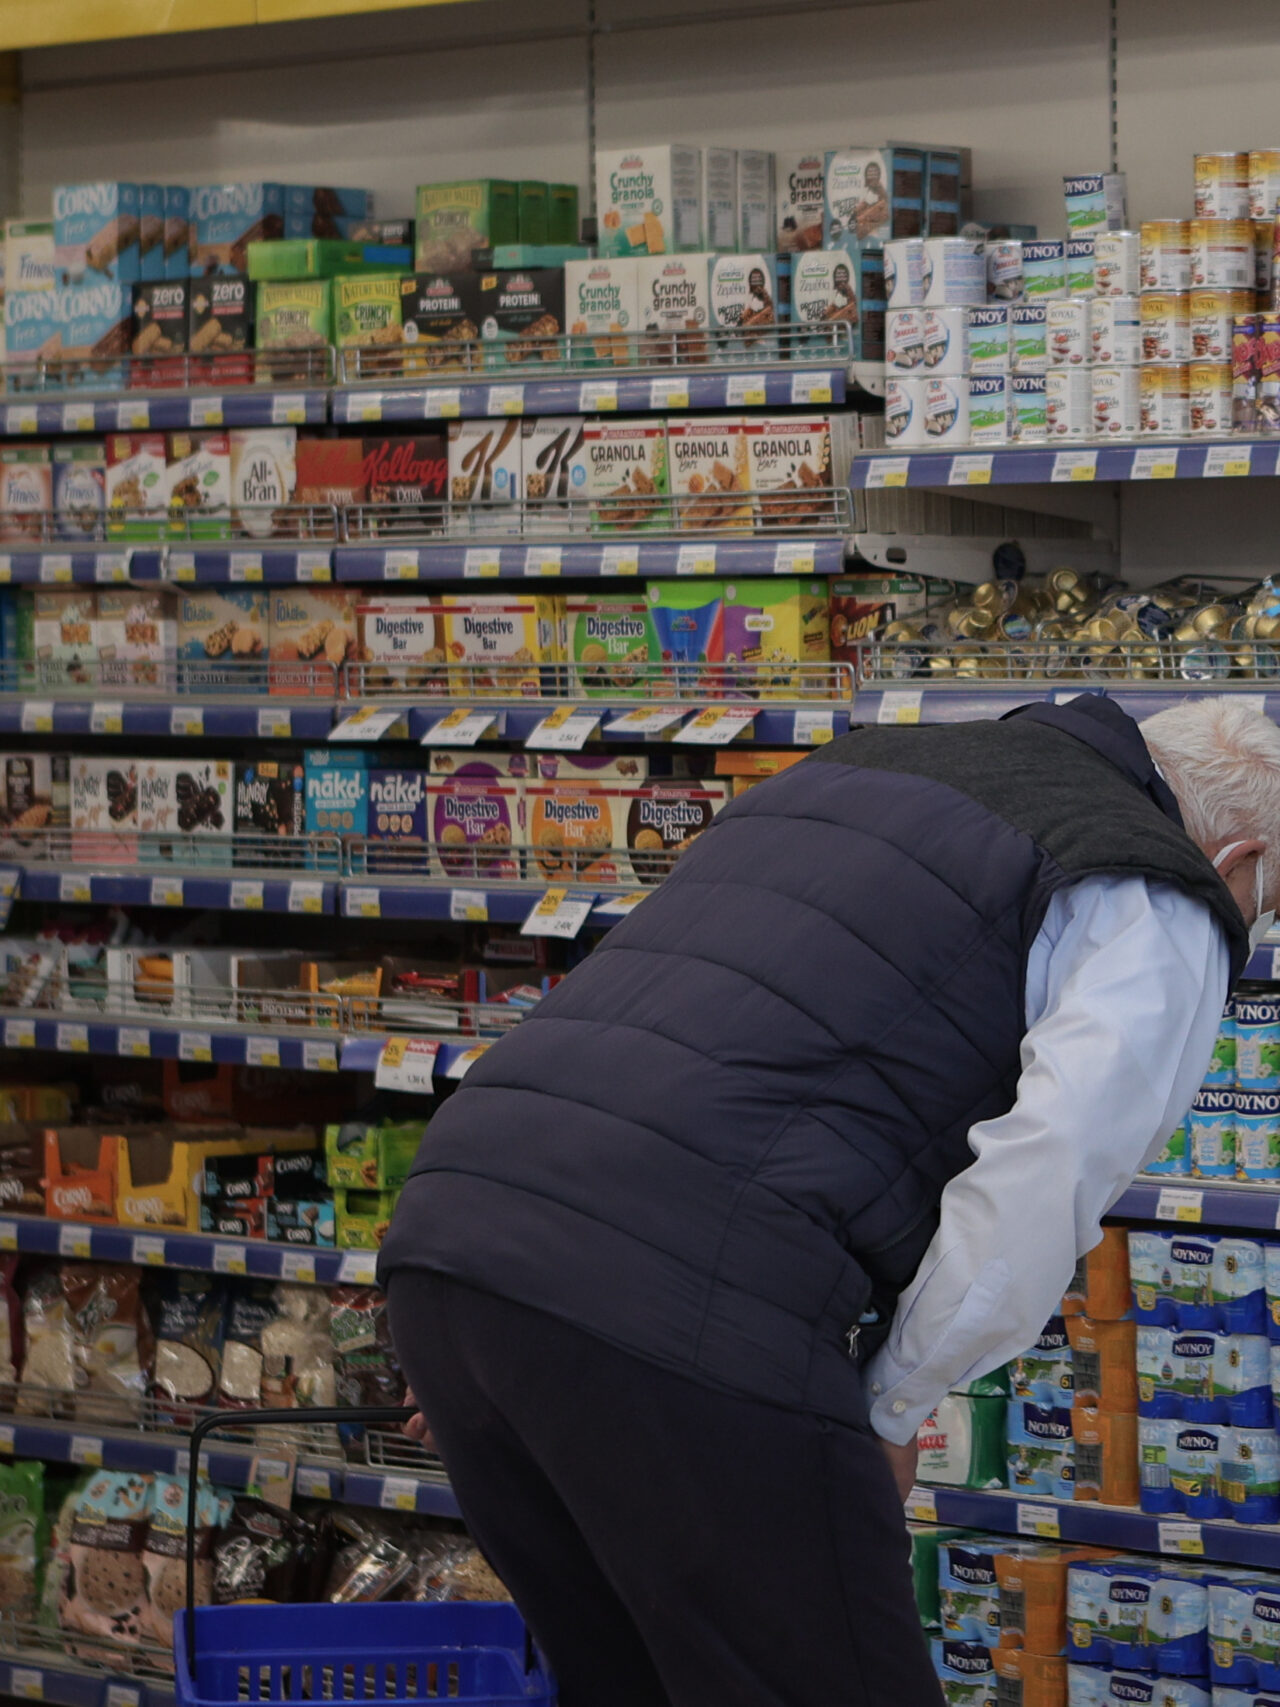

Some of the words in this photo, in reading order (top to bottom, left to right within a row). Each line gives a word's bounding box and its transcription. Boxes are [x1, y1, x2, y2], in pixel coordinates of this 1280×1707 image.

[610, 172, 653, 190] Crunchy
[789, 172, 824, 190] Crunch
[611, 187, 654, 203] granola
[212, 282, 244, 300] zero
[578, 282, 620, 301] Crunchy
[652, 279, 696, 297] Crunchy
[153, 289, 184, 306] zero
[420, 297, 459, 312] PROTEIN
[500, 293, 540, 307] PROTEIN
[579, 297, 620, 314] granola
[653, 294, 697, 310] granola
[354, 304, 392, 323] CRUNCHY
[591, 445, 646, 462] GRANOLA
[675, 441, 729, 459] GRANOLA
[753, 440, 811, 457] GRANOLA
[243, 480, 277, 501] Bran
[376, 618, 424, 637] Digestive
[463, 618, 514, 638] Digestive
[586, 616, 643, 639] Digestive
[393, 635, 408, 650] Bar
[482, 636, 498, 651] Bar
[608, 638, 629, 655] Bar
[446, 799, 498, 820] Digestive
[544, 800, 599, 821] Digestive
[641, 802, 703, 825] Digestive
[465, 819, 486, 836] Bar
[564, 821, 585, 838] Bar
[663, 824, 687, 841] Bar
